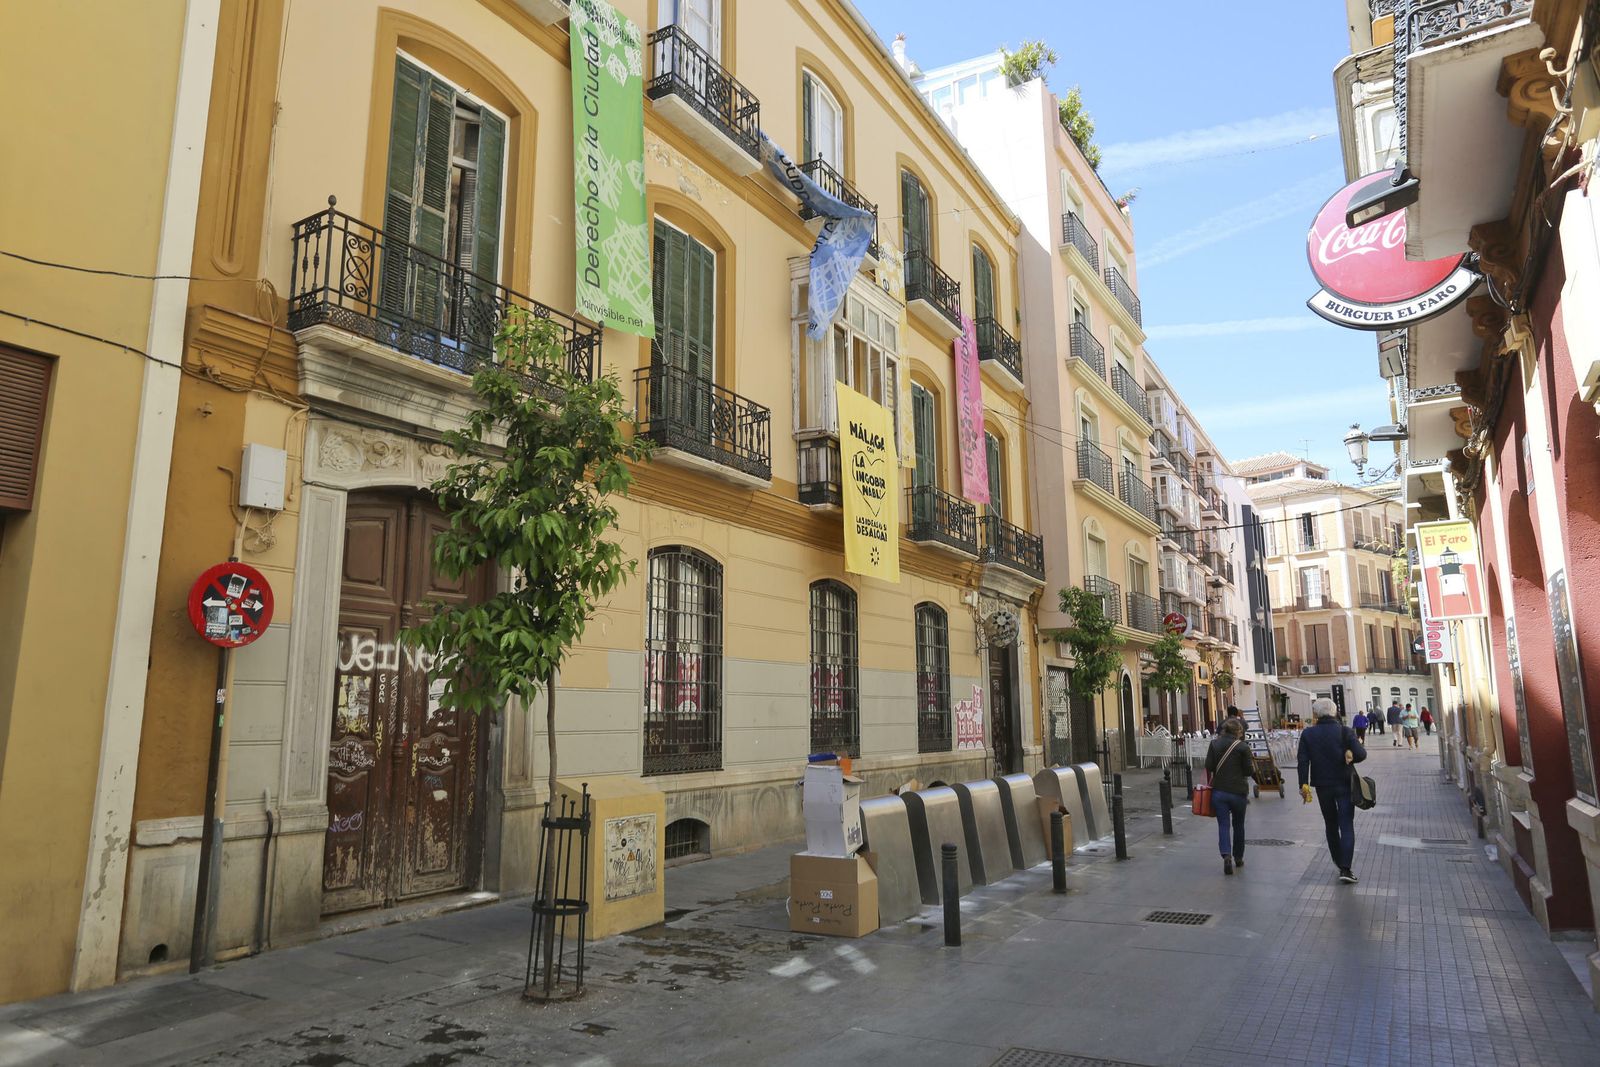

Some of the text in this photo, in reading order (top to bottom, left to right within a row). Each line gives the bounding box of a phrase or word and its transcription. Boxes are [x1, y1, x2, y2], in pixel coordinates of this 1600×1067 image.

[584, 27, 600, 289] Derecho a la Ciudad
[581, 295, 643, 328] lainvisible.net
[1325, 284, 1458, 322] BURGUER EL FARO
[849, 420, 885, 452] MÁLAGA
[855, 454, 866, 469] LA
[1424, 534, 1468, 547] El Faro
